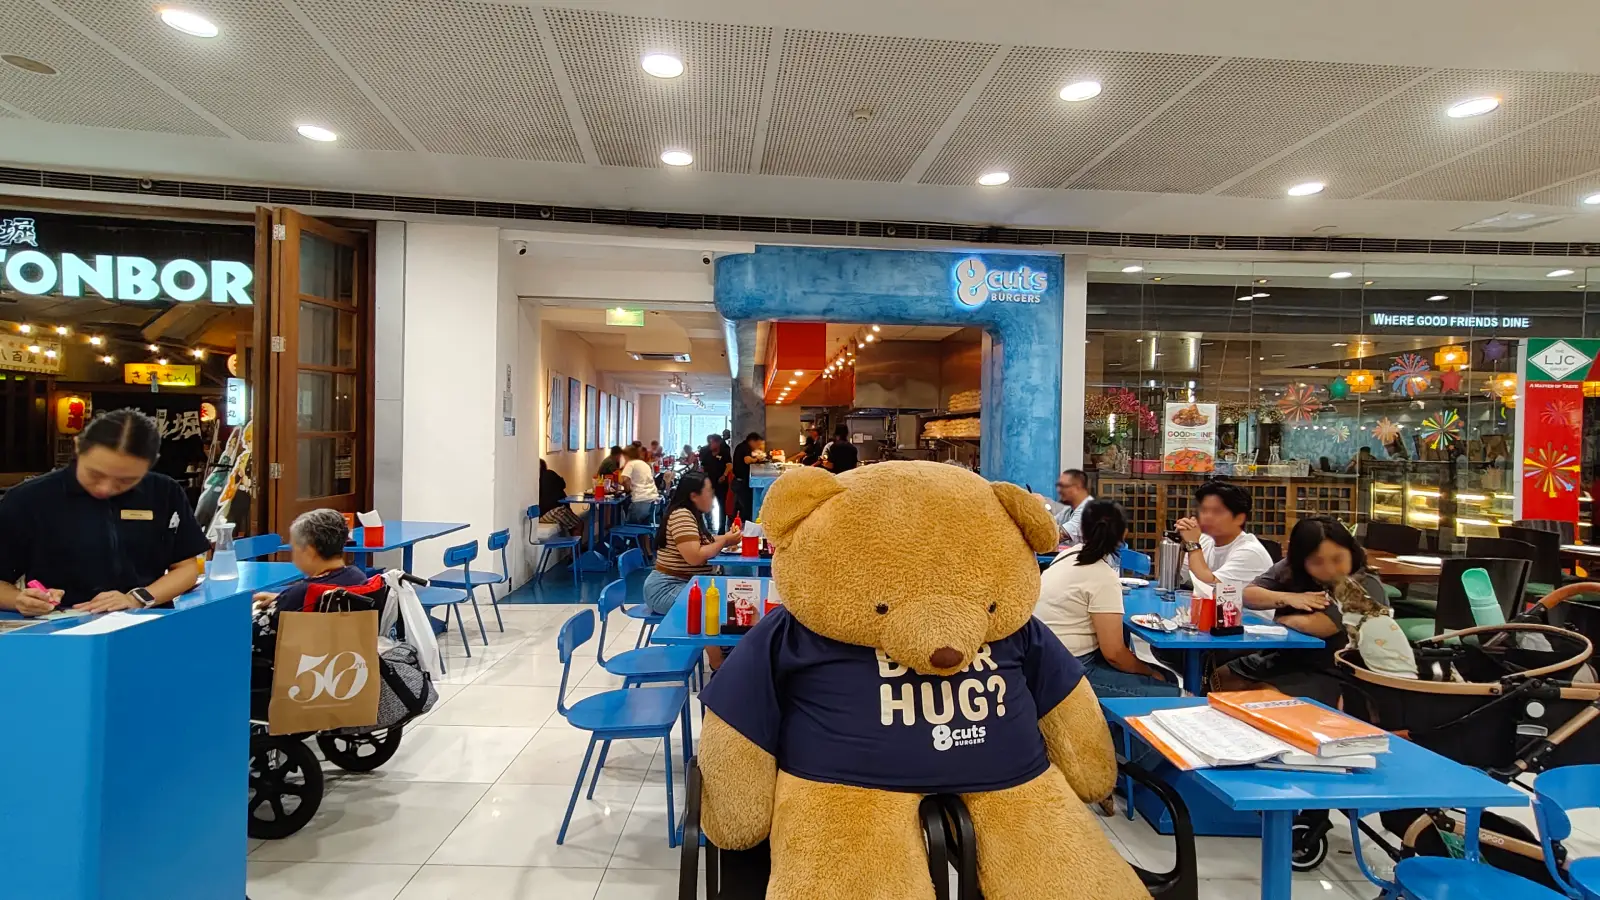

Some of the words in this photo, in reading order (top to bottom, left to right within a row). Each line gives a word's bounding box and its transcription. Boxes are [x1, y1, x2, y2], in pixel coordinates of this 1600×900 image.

[0, 248, 254, 305] ONBOR
[955, 258, 1048, 306] 8cuts
[990, 292, 1041, 304] BURGERS
[1373, 312, 1415, 326] WHERE
[1417, 315, 1448, 327] GOOD
[1450, 316, 1499, 328] FRIENDS
[1502, 317, 1530, 328] DINE
[1544, 355, 1575, 365] LJC
[875, 643, 998, 678] BR
[288, 651, 369, 703] 50
[879, 674, 1007, 726] HUG?
[931, 724, 987, 751] 8cuts
[954, 738, 985, 747] BURGERS
